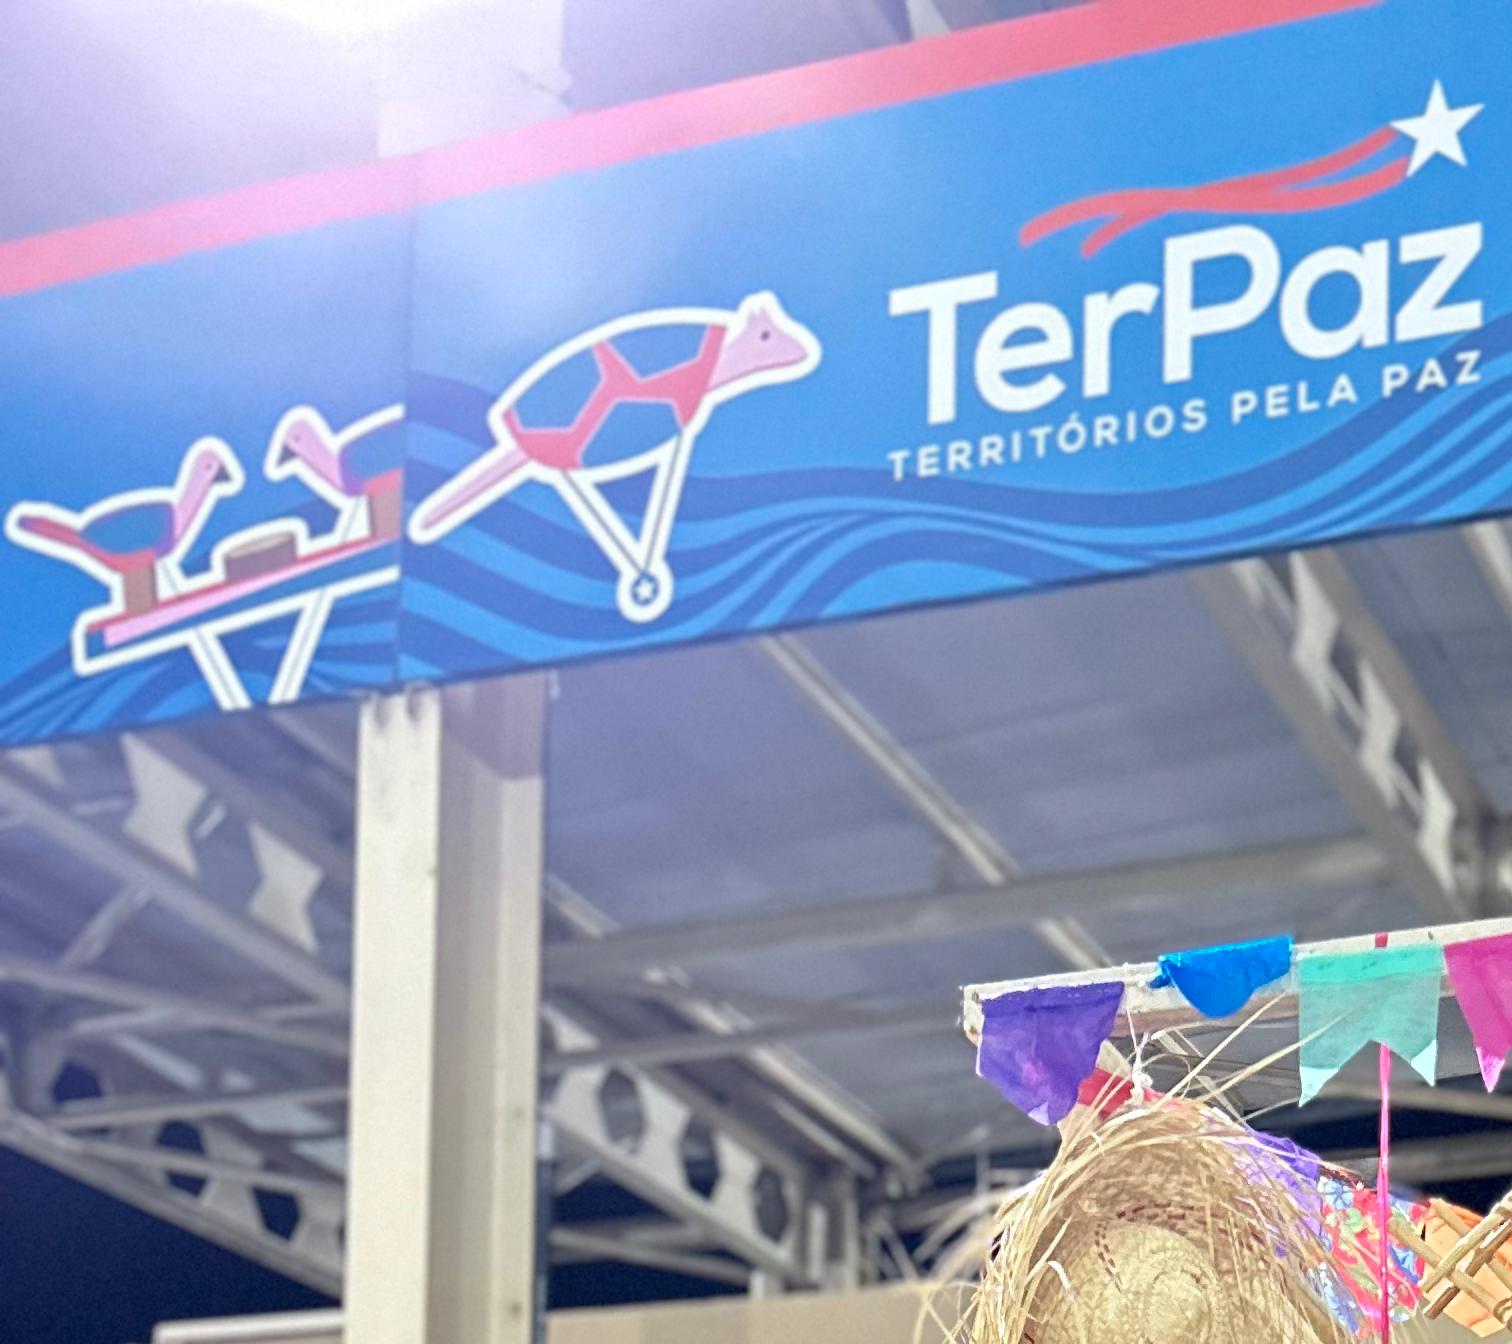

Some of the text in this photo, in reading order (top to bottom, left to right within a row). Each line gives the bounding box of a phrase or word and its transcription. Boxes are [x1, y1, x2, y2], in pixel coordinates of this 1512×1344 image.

[888, 222, 1484, 426] TerPaz
[887, 350, 1482, 481] TERRITÓRIOS PELA PAZ
